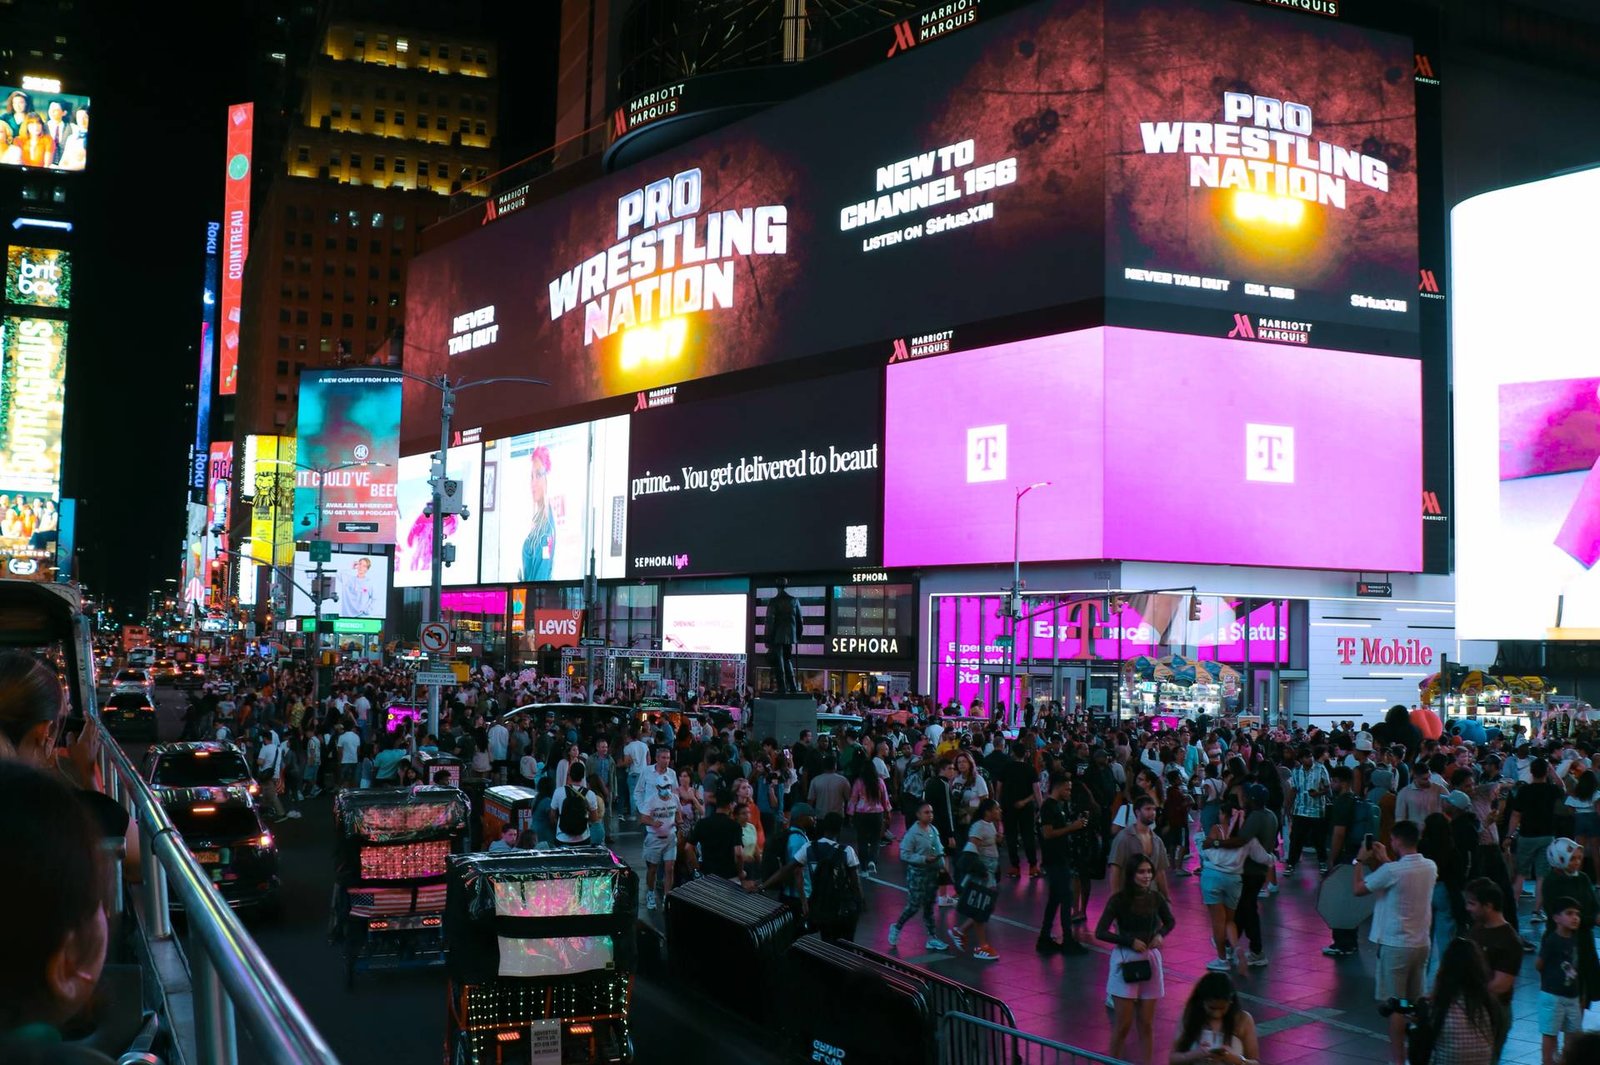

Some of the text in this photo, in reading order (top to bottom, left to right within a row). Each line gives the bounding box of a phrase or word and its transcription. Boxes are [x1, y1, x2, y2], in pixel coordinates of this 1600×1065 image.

[921, 10, 975, 40] MARQUIS
[1415, 76, 1440, 85] MARRIOTT
[630, 84, 685, 112] MARRIOTT
[630, 101, 677, 126] MARQUIS
[1223, 91, 1312, 136] PRO
[876, 139, 974, 192] NEW TO
[1140, 121, 1389, 192] WRESTLING
[498, 185, 530, 203] MARRIOTT
[840, 157, 1017, 231] CHANNEL 156
[1190, 155, 1346, 210] NATION
[498, 197, 526, 215] MARQUIS
[617, 167, 702, 240] PRO
[863, 203, 994, 252] LISTEN ON SiriusXM
[229, 210, 243, 280] COINTREAU
[21, 258, 59, 281] brit
[548, 205, 788, 321] WRESTLING
[18, 274, 59, 297] box
[1124, 267, 1172, 286] NEVER
[584, 261, 734, 346] NATION
[1420, 292, 1445, 300] MARRIOTT
[453, 305, 495, 334] NEVER
[1259, 318, 1313, 333] MARRIOTT
[473, 325, 499, 350] OUT
[911, 330, 953, 345] MARRIOTT
[1258, 329, 1307, 342] MARQUIS
[911, 342, 949, 355] MARQUIS
[648, 396, 674, 407] MARQUIS
[649, 386, 677, 398] MARRIOTT
[194, 454, 208, 488] Roku
[298, 472, 309, 486] IT
[632, 471, 681, 500] prime...
[682, 466, 707, 490] You
[709, 463, 734, 491] get
[735, 449, 806, 484] delivered
[809, 452, 827, 476] to
[634, 554, 688, 569] SEPHORA lyft
[852, 573, 888, 582] SEPHORA
[832, 638, 899, 653] SEPHORA
[1360, 638, 1433, 666] Mobile
[967, 888, 993, 911] GAP
